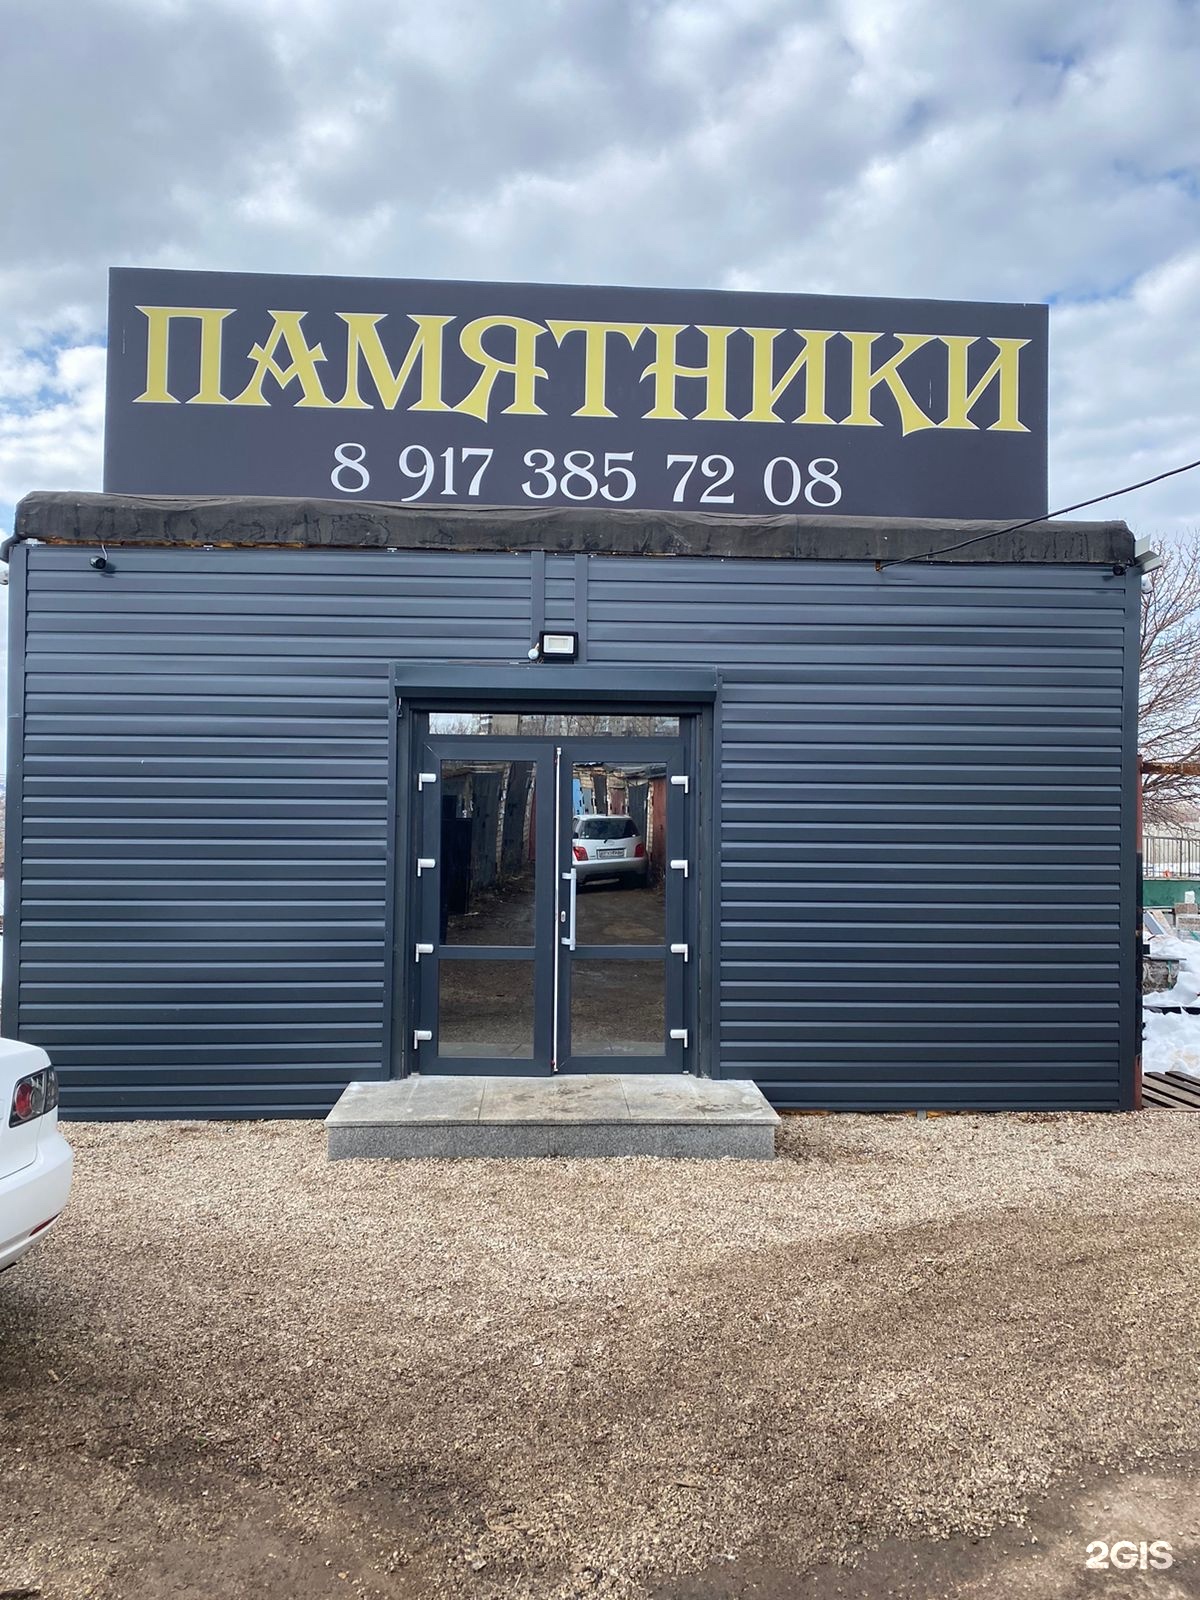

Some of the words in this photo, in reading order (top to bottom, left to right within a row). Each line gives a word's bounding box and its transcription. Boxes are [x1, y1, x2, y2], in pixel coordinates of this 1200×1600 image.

[132, 304, 1032, 437] ПАМЯТНИКИ
[330, 442, 371, 493] 8
[398, 444, 494, 502] 917
[521, 449, 637, 502] 385
[666, 454, 735, 504] 72
[763, 457, 842, 507] 08
